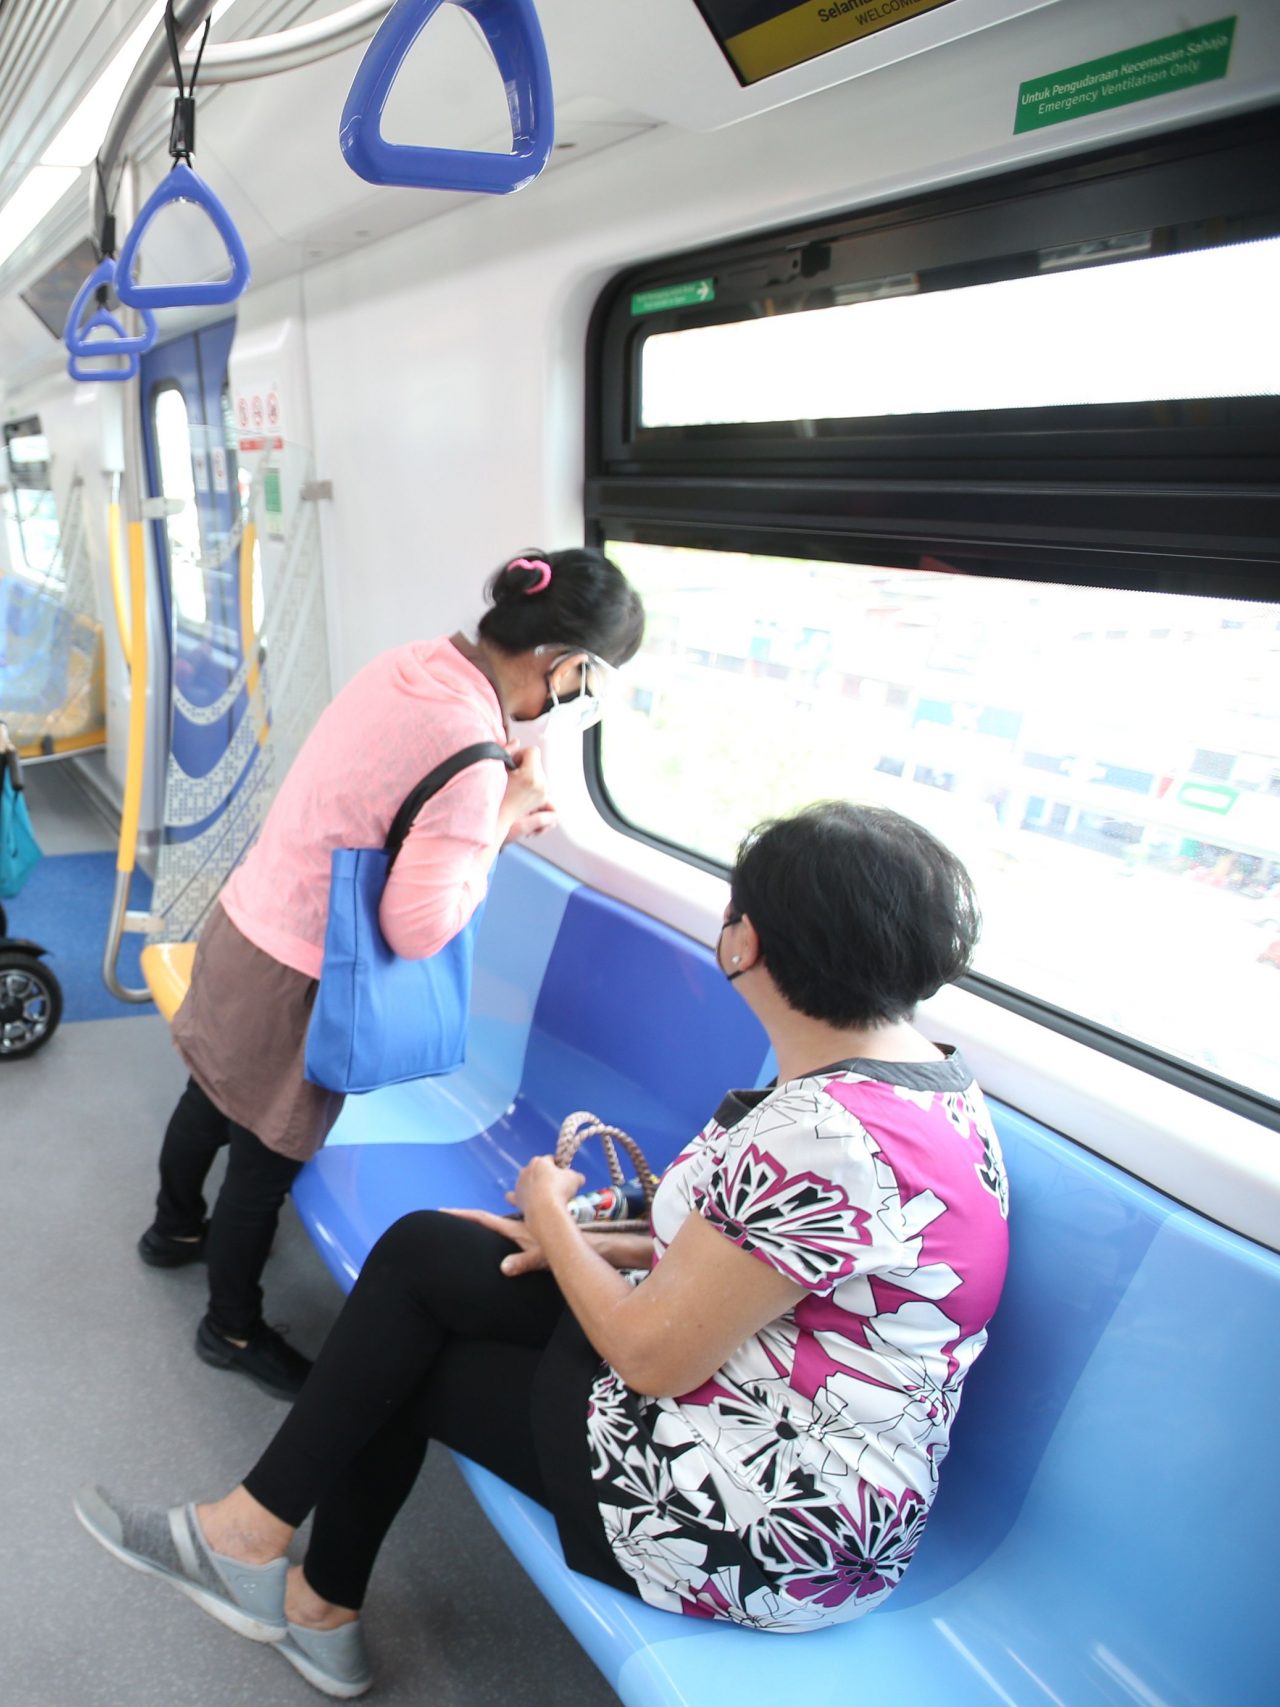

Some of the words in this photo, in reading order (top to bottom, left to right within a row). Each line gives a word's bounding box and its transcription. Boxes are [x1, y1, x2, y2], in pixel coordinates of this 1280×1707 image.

[855, 0, 921, 25] WELCOM
[1021, 87, 1051, 105] Untuk
[1052, 69, 1119, 96] Pengudaraan
[1120, 49, 1184, 76] Kecemasan
[1038, 89, 1099, 115] Emergency
[1101, 70, 1168, 97] Ventilation
[1169, 59, 1201, 78] Only
